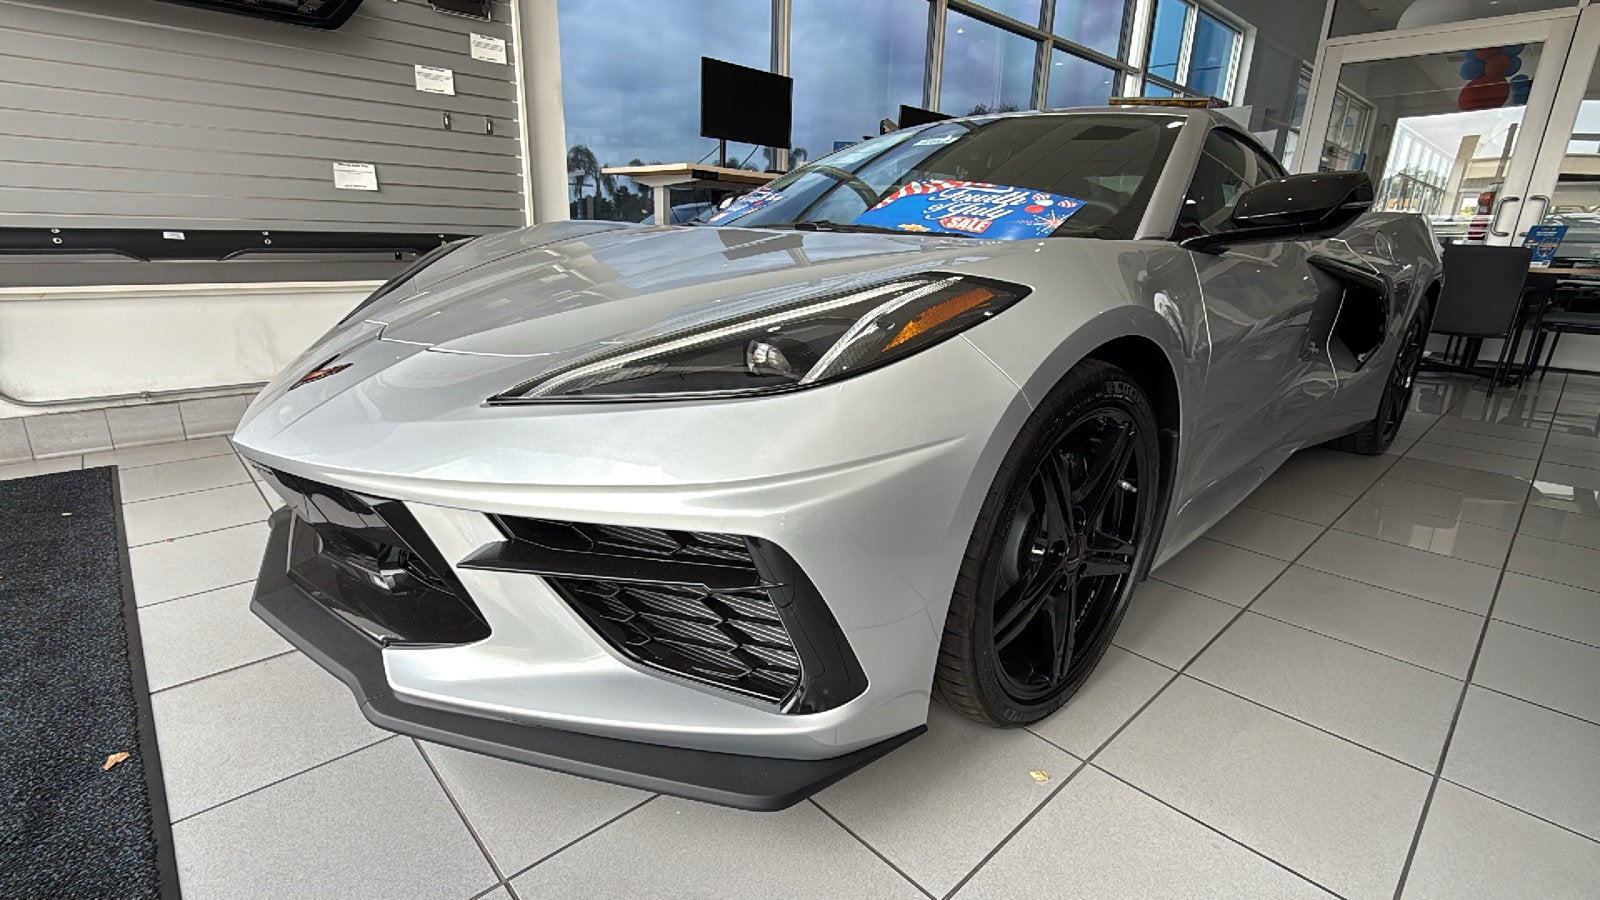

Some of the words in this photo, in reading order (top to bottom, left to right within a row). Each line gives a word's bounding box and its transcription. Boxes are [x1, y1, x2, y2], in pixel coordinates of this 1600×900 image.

[928, 186, 1031, 206] Fourth
[925, 202, 1014, 221] July
[945, 217, 989, 233] SALE
